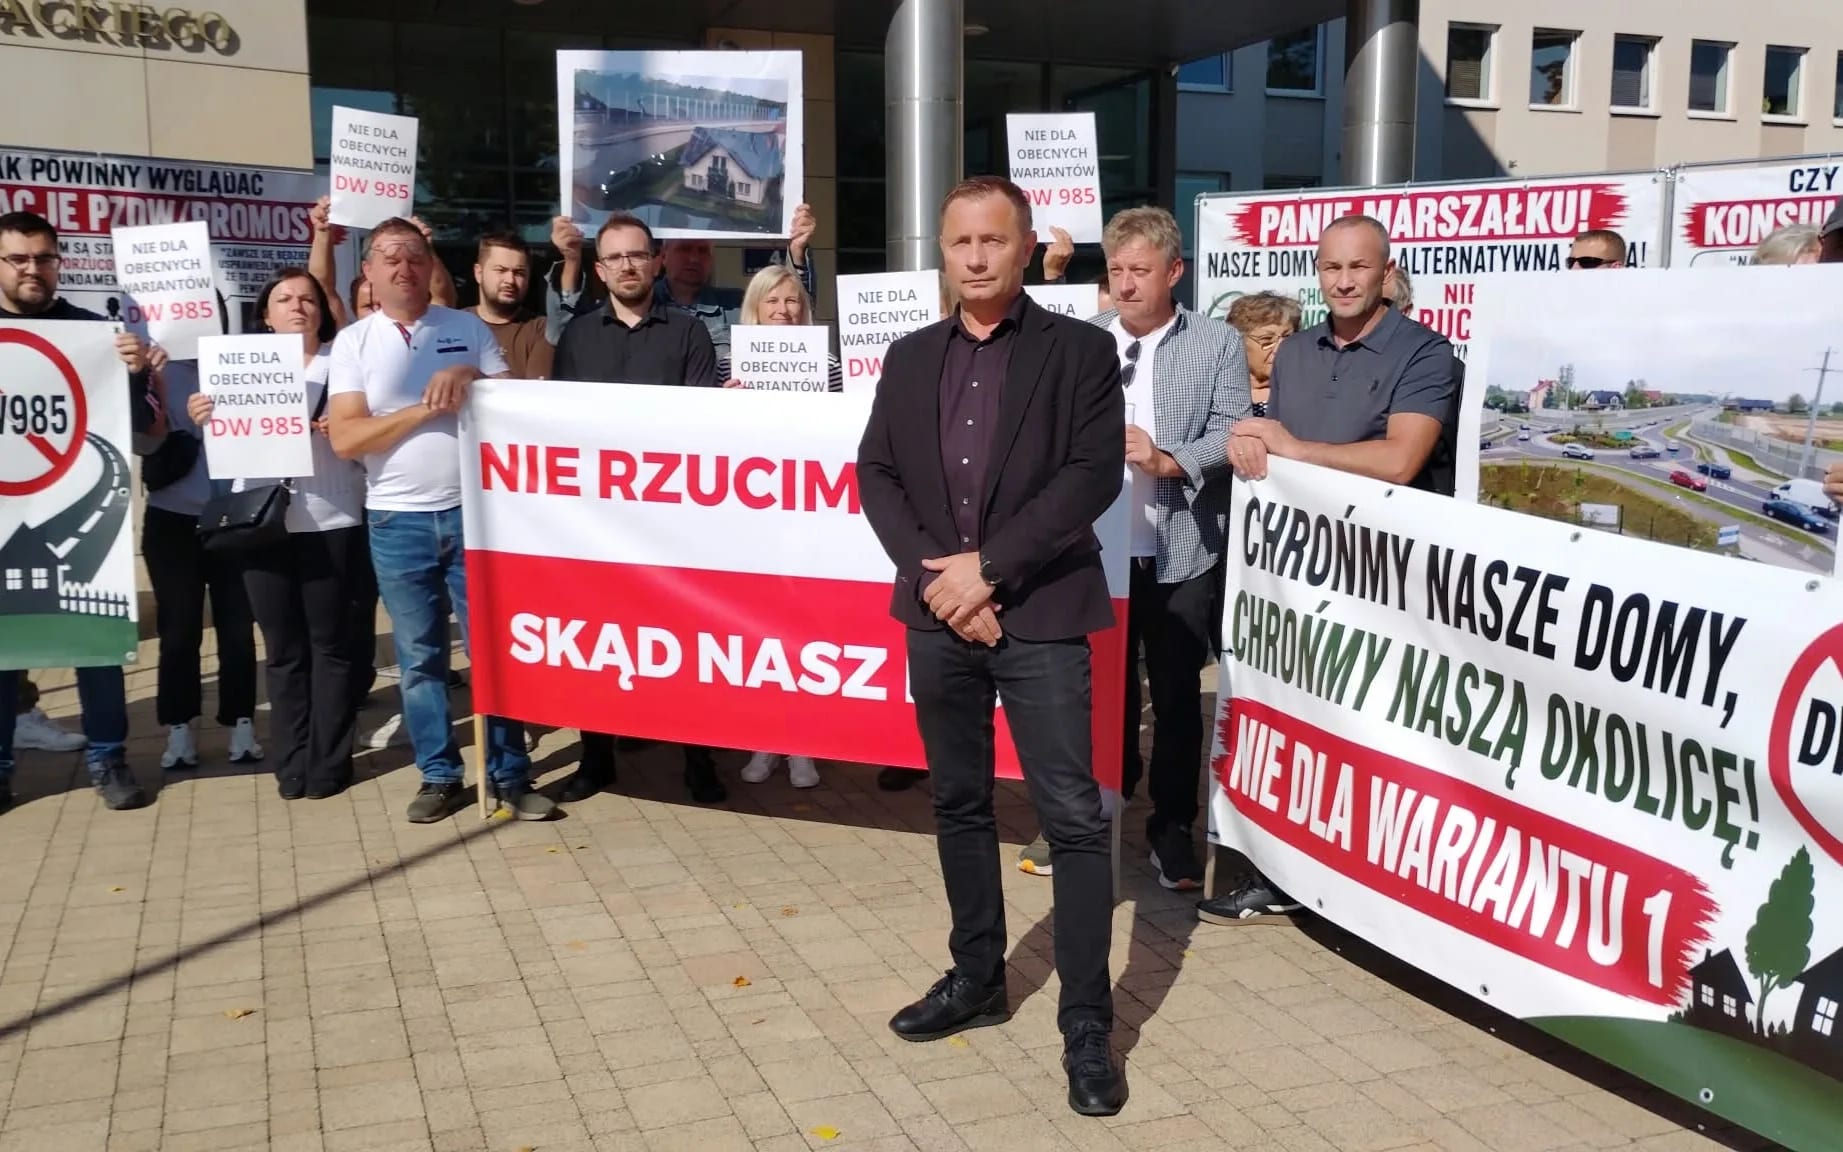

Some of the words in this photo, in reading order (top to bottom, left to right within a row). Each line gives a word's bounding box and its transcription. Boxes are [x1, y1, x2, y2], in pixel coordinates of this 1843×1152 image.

[348, 123, 370, 136] NIE
[373, 127, 399, 140] DLA
[1024, 130, 1047, 141] NIE
[1050, 129, 1077, 141] DLA
[339, 139, 407, 158] OBECNYCH
[1016, 147, 1088, 160] OBECNYCH
[0, 156, 21, 181] K
[31, 158, 140, 188] POWINNY
[332, 154, 413, 175] WARIANTÓW
[1011, 164, 1096, 178] WARIANTÓW
[335, 174, 369, 194] DW
[374, 181, 409, 199] 985
[1789, 166, 1839, 193] CZY
[1058, 187, 1096, 205] 985
[1362, 188, 1593, 239] MARSZAŁKU!
[132, 241, 157, 255] NIE
[159, 239, 189, 253] DLA
[124, 258, 201, 274] OBECNYCH
[1207, 251, 1261, 278] NASZE
[120, 275, 211, 294] WARIANTÓW
[857, 291, 883, 304] NIE
[887, 288, 918, 302] DLA
[127, 303, 163, 324] DW
[169, 300, 214, 321] 985
[848, 308, 929, 325] OBECNYCH
[750, 341, 775, 353] NIE
[779, 341, 808, 353] DLA
[841, 329, 916, 347] WARIAN
[218, 352, 246, 365] NIE
[249, 351, 281, 364] DLA
[740, 361, 818, 373] OBECNYCH
[848, 357, 883, 377] DW
[209, 371, 295, 386] OBECNYCH
[209, 417, 252, 437] DW
[259, 416, 304, 436] 985
[479, 442, 581, 497] NIE
[599, 449, 862, 515] RZUCIM
[1242, 497, 1415, 613] CHROŃMY
[1426, 544, 1570, 658] NASZE
[1573, 582, 1748, 729] DOMY,
[509, 613, 683, 691] SKĄD
[698, 632, 888, 702] NASZ
[1231, 591, 1392, 712] CHROŃMY
[1385, 643, 1528, 790] NASZĄ
[1539, 694, 1761, 870] OKOLICĘ!
[1797, 697, 1843, 776] D
[1229, 712, 1286, 803] NIE
[1286, 742, 1355, 851] DLA
[1366, 775, 1628, 967] WARIANTU
[1642, 890, 1673, 988] 1
